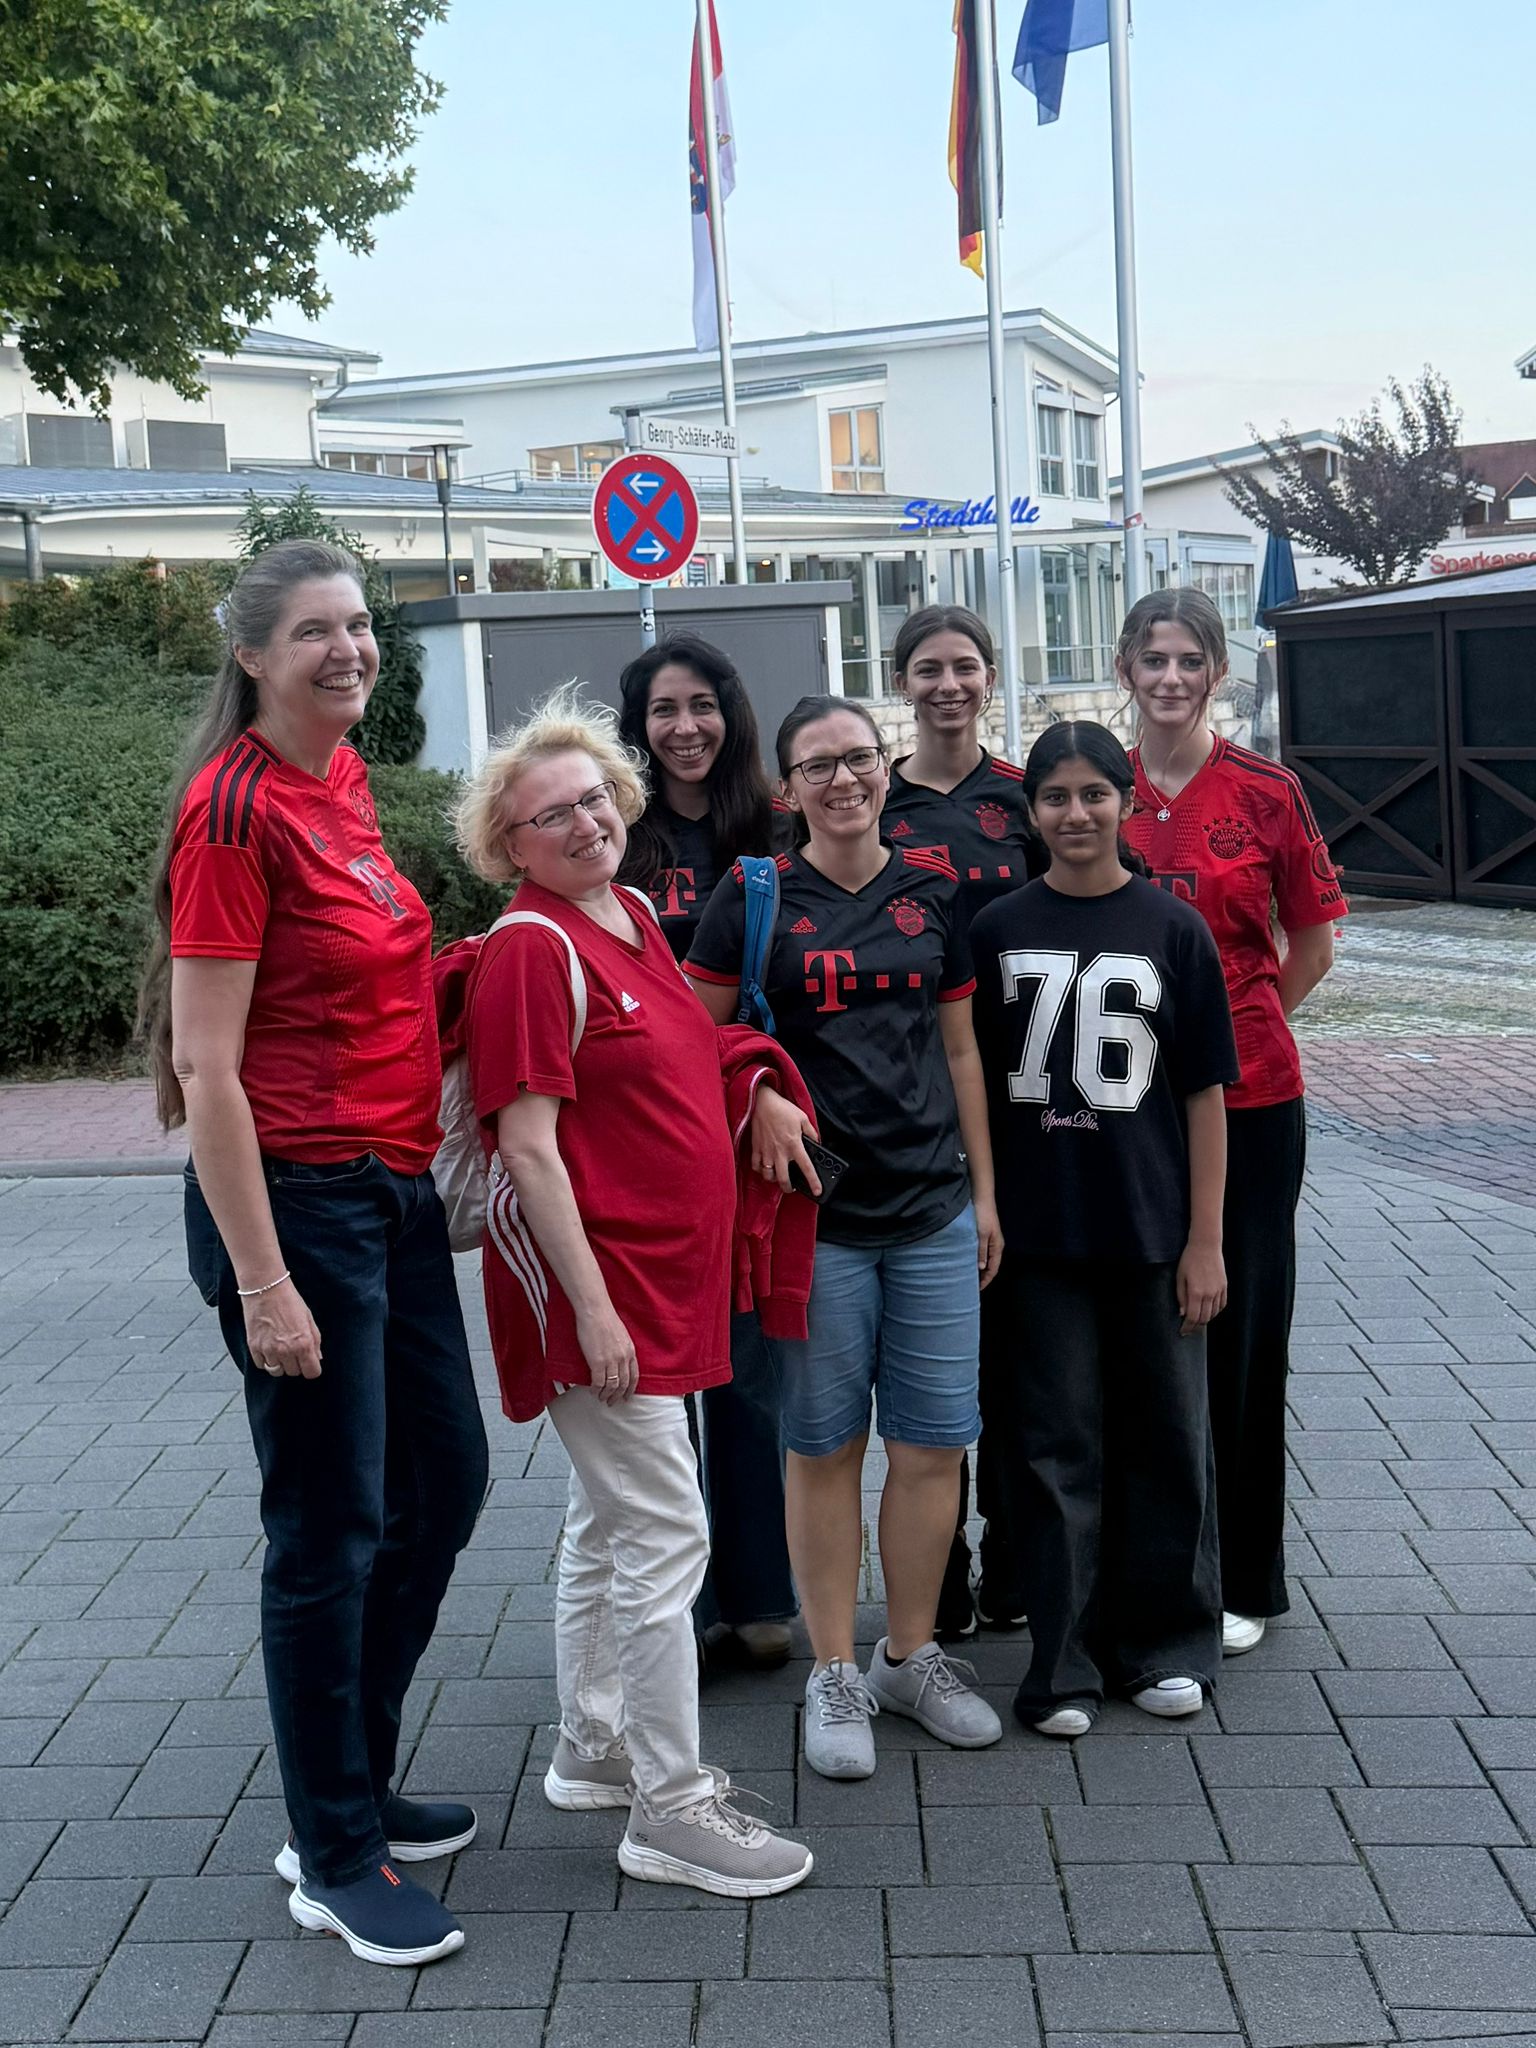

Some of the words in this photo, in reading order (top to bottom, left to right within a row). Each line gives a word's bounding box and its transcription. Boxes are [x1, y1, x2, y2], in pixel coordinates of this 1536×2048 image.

[648, 422, 735, 450] Georg-Schäfer-Platz
[899, 495, 1040, 531] Stadthlle
[998, 949, 1162, 1112] 76
[1041, 1108, 1073, 1133] Sports
[1072, 1109, 1100, 1131] Div.
